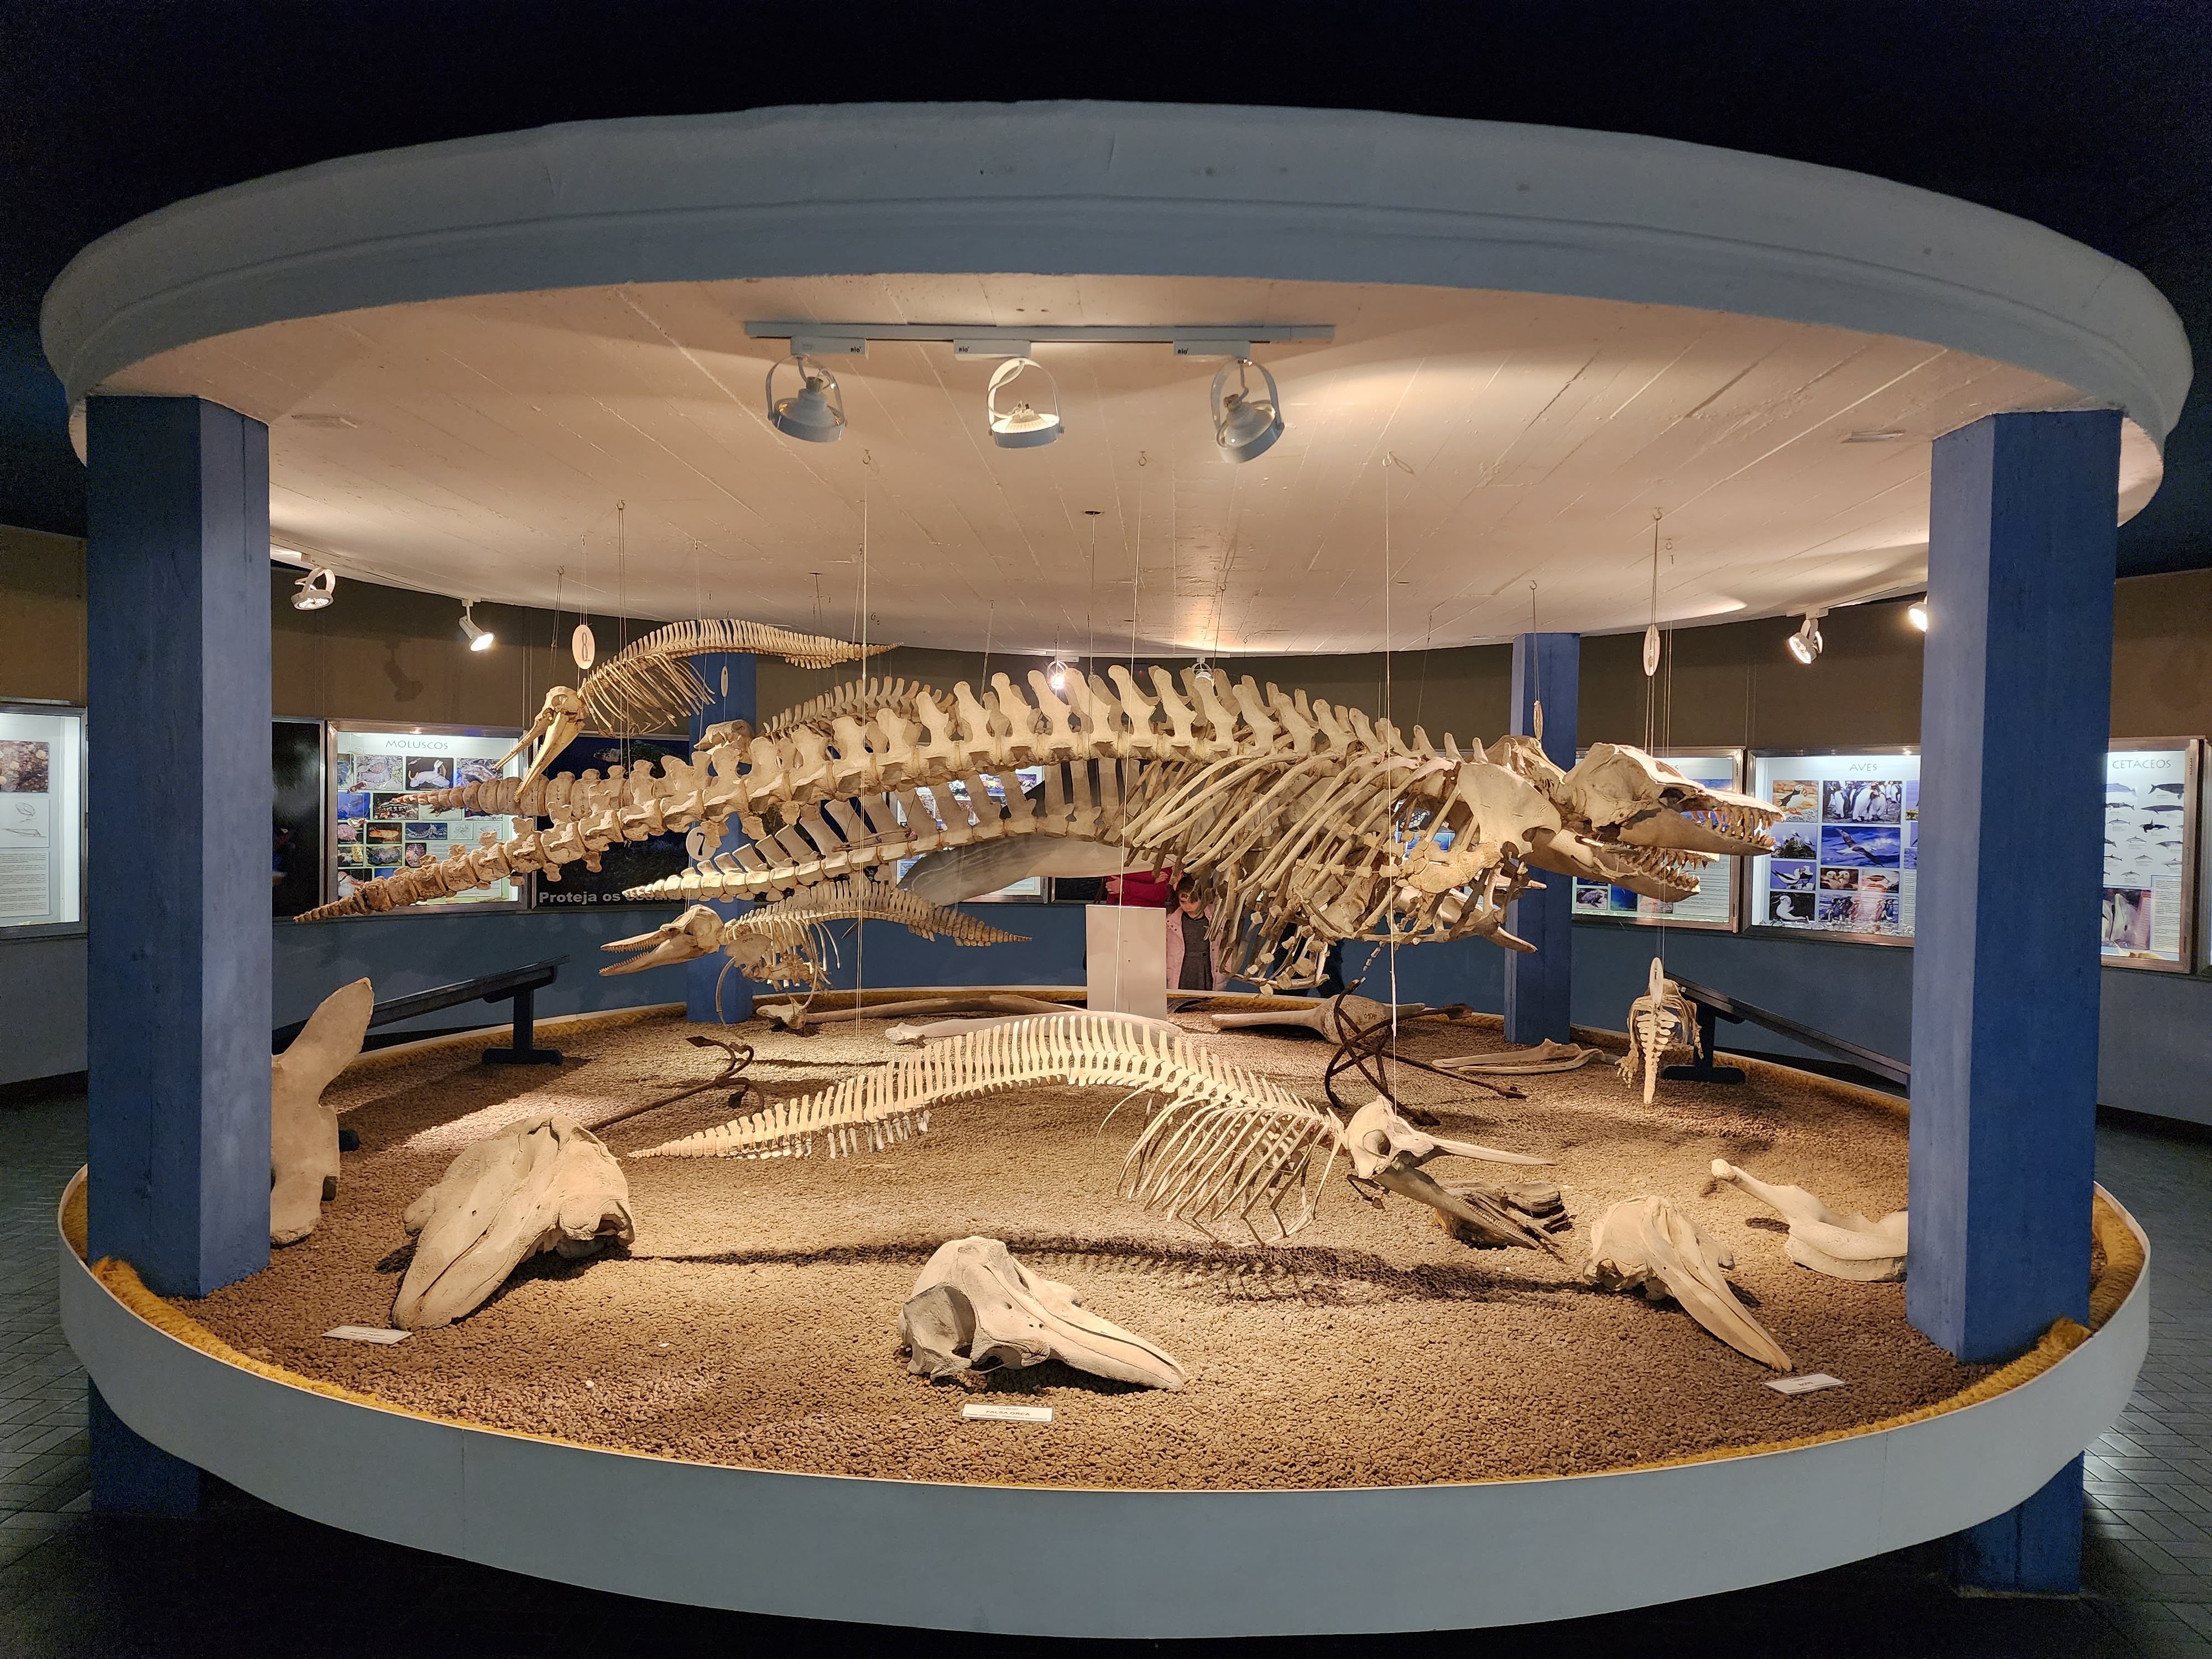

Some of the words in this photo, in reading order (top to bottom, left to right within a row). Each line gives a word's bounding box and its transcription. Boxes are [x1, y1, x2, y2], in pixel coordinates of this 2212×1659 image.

[385, 740, 448, 750] MOLUSCOS
[1849, 763, 1877, 771] AVES
[2112, 758, 2172, 769] CETÁCEOS
[539, 891, 598, 905] Proteja
[602, 893, 621, 902] os
